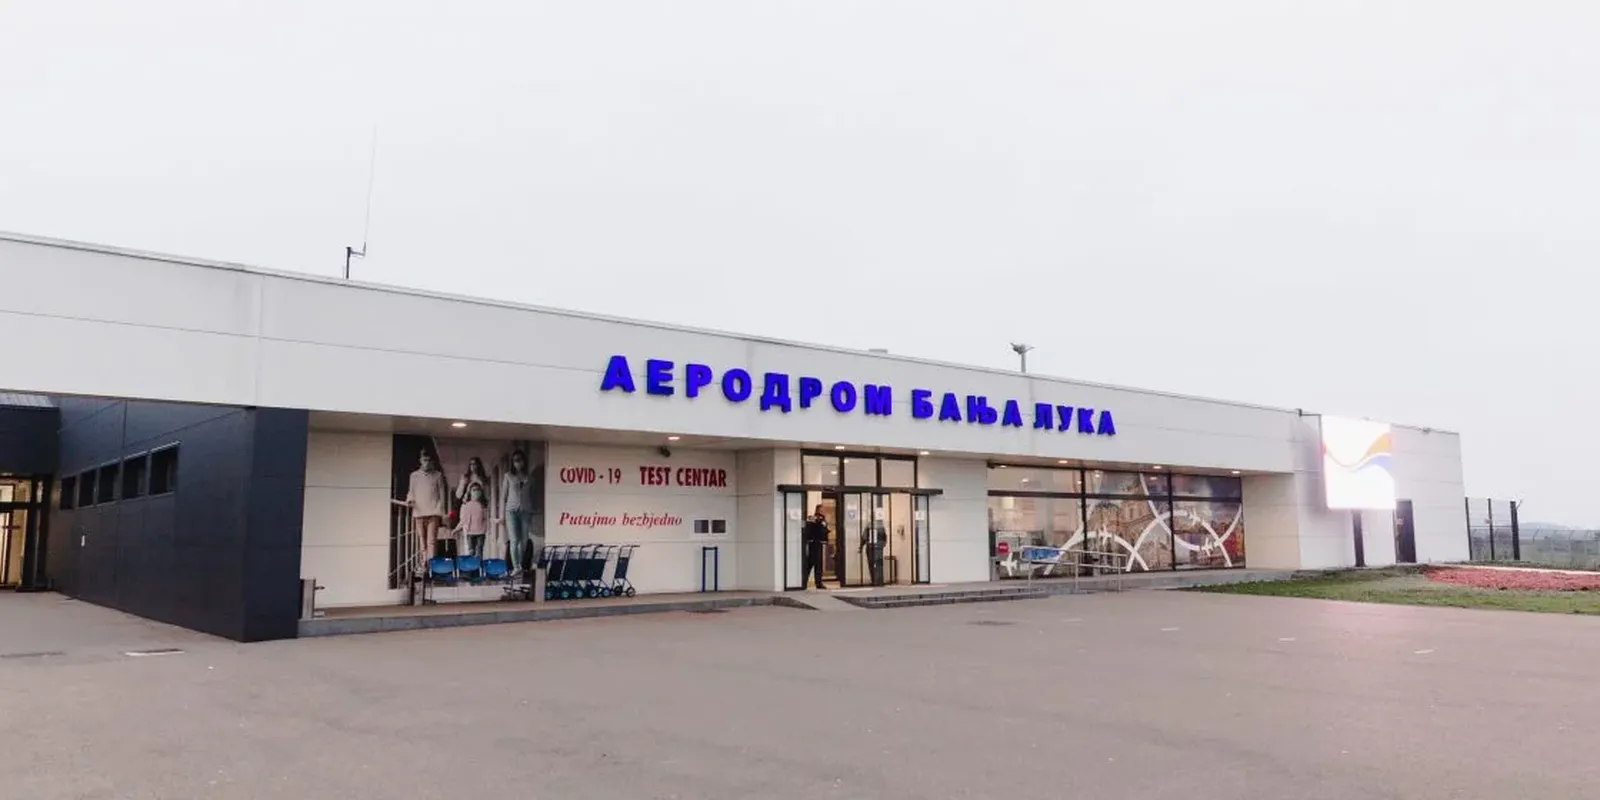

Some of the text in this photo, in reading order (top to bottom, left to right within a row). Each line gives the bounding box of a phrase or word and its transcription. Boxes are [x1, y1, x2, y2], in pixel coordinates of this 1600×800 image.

[600, 354, 1117, 436] АЕРОДРОМ БАЊА ЛУКА
[559, 466, 596, 484] COVID
[608, 468, 622, 486] 19
[640, 466, 672, 486] TEST
[676, 467, 727, 488] CENTAR
[559, 511, 683, 529] Putujmo bezbjedno
